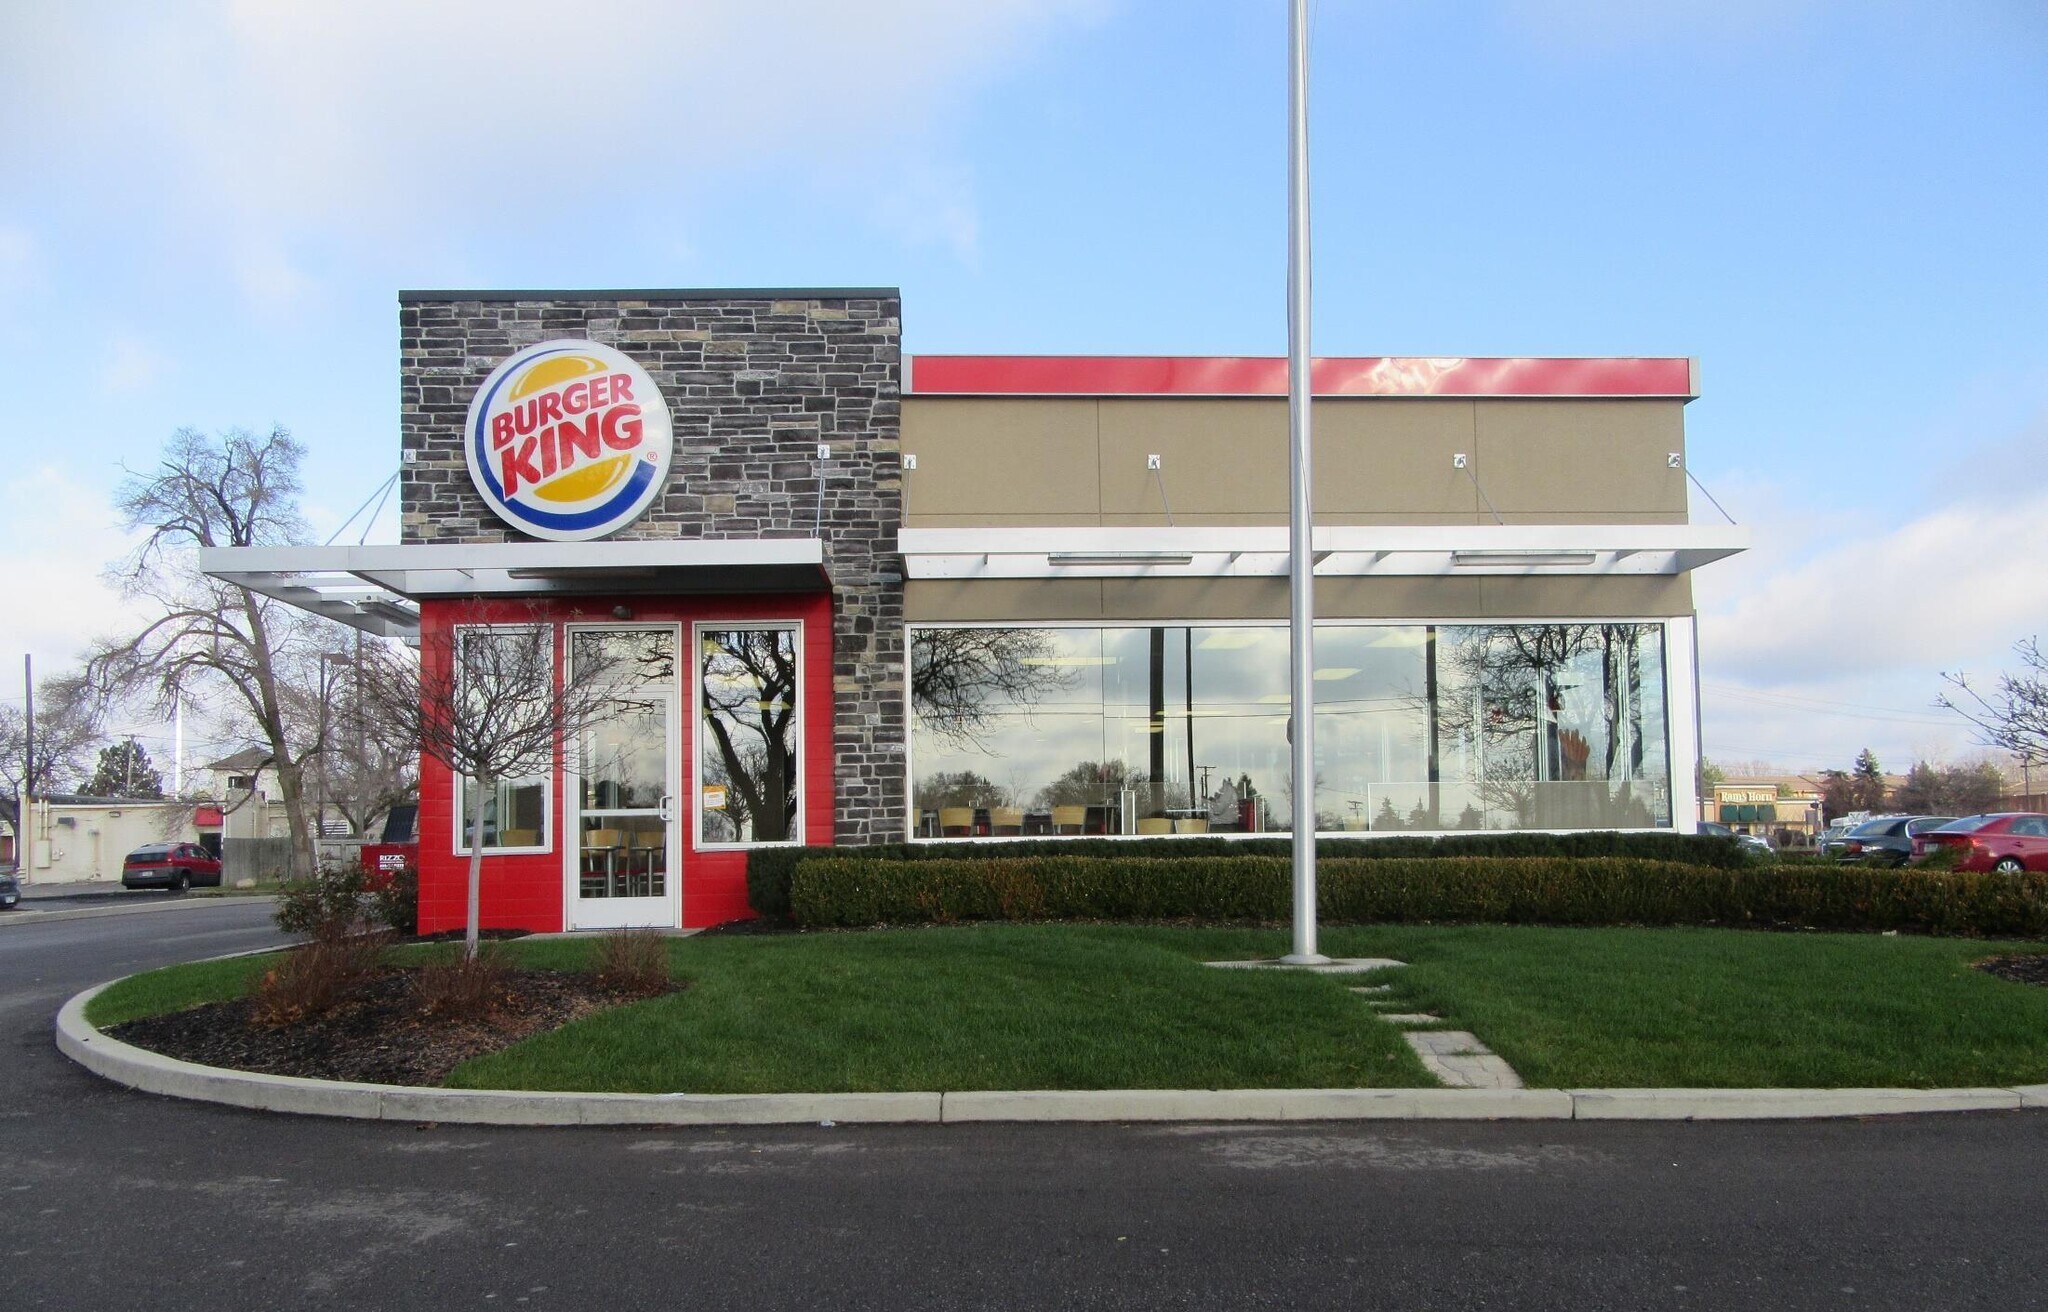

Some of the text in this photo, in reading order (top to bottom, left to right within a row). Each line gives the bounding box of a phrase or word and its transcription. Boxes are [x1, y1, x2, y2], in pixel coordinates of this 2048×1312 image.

[492, 373, 635, 452] BURGER
[501, 403, 644, 499] KING
[1721, 791, 1773, 802] Ram's Horn
